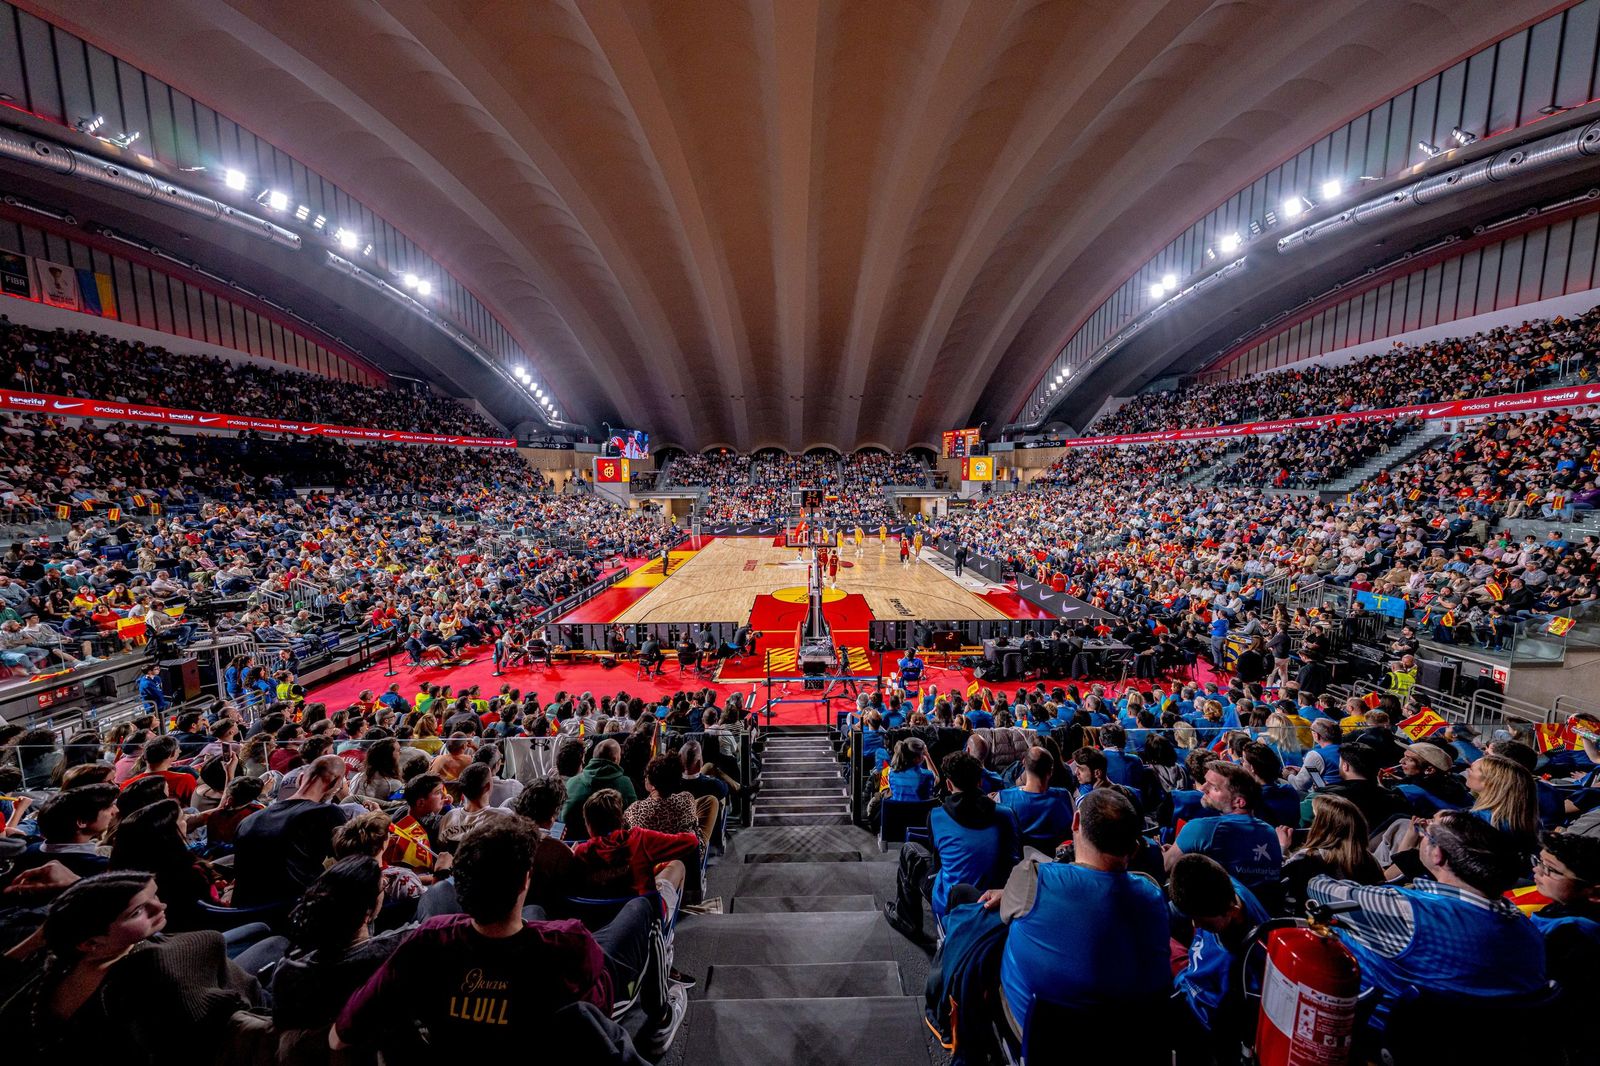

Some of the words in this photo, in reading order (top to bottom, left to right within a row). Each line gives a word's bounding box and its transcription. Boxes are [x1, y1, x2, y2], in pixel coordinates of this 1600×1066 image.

[5, 274, 26, 288] FIBA
[94, 406, 125, 414] endesa
[1461, 403, 1490, 411] endesa
[449, 996, 509, 1025] LLULL
